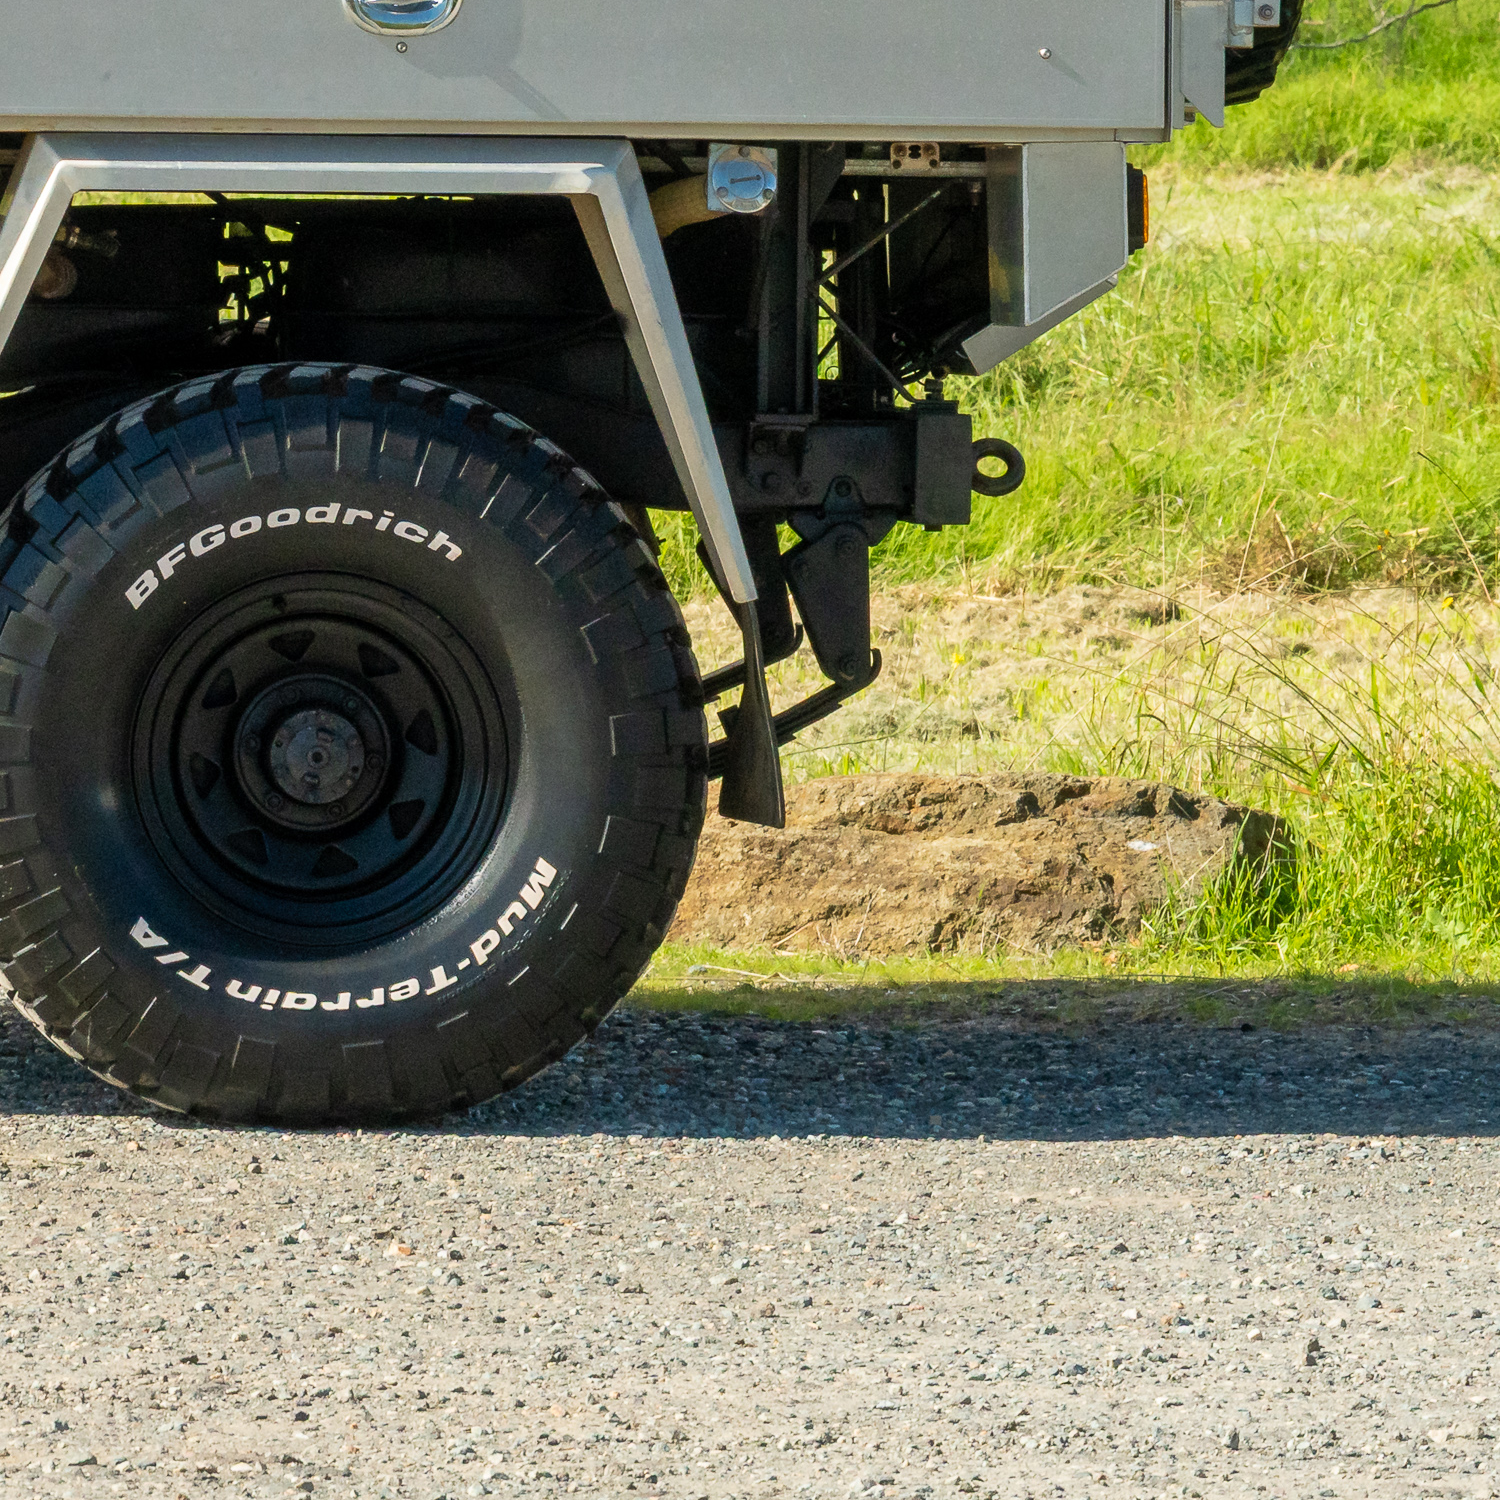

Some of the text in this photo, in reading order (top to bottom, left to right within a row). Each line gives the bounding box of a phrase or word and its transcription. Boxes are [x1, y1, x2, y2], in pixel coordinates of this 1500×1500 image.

[125, 502, 463, 610] BFGoodrich
[129, 916, 211, 991] T/A
[225, 856, 558, 1012] Mud-Terrain
